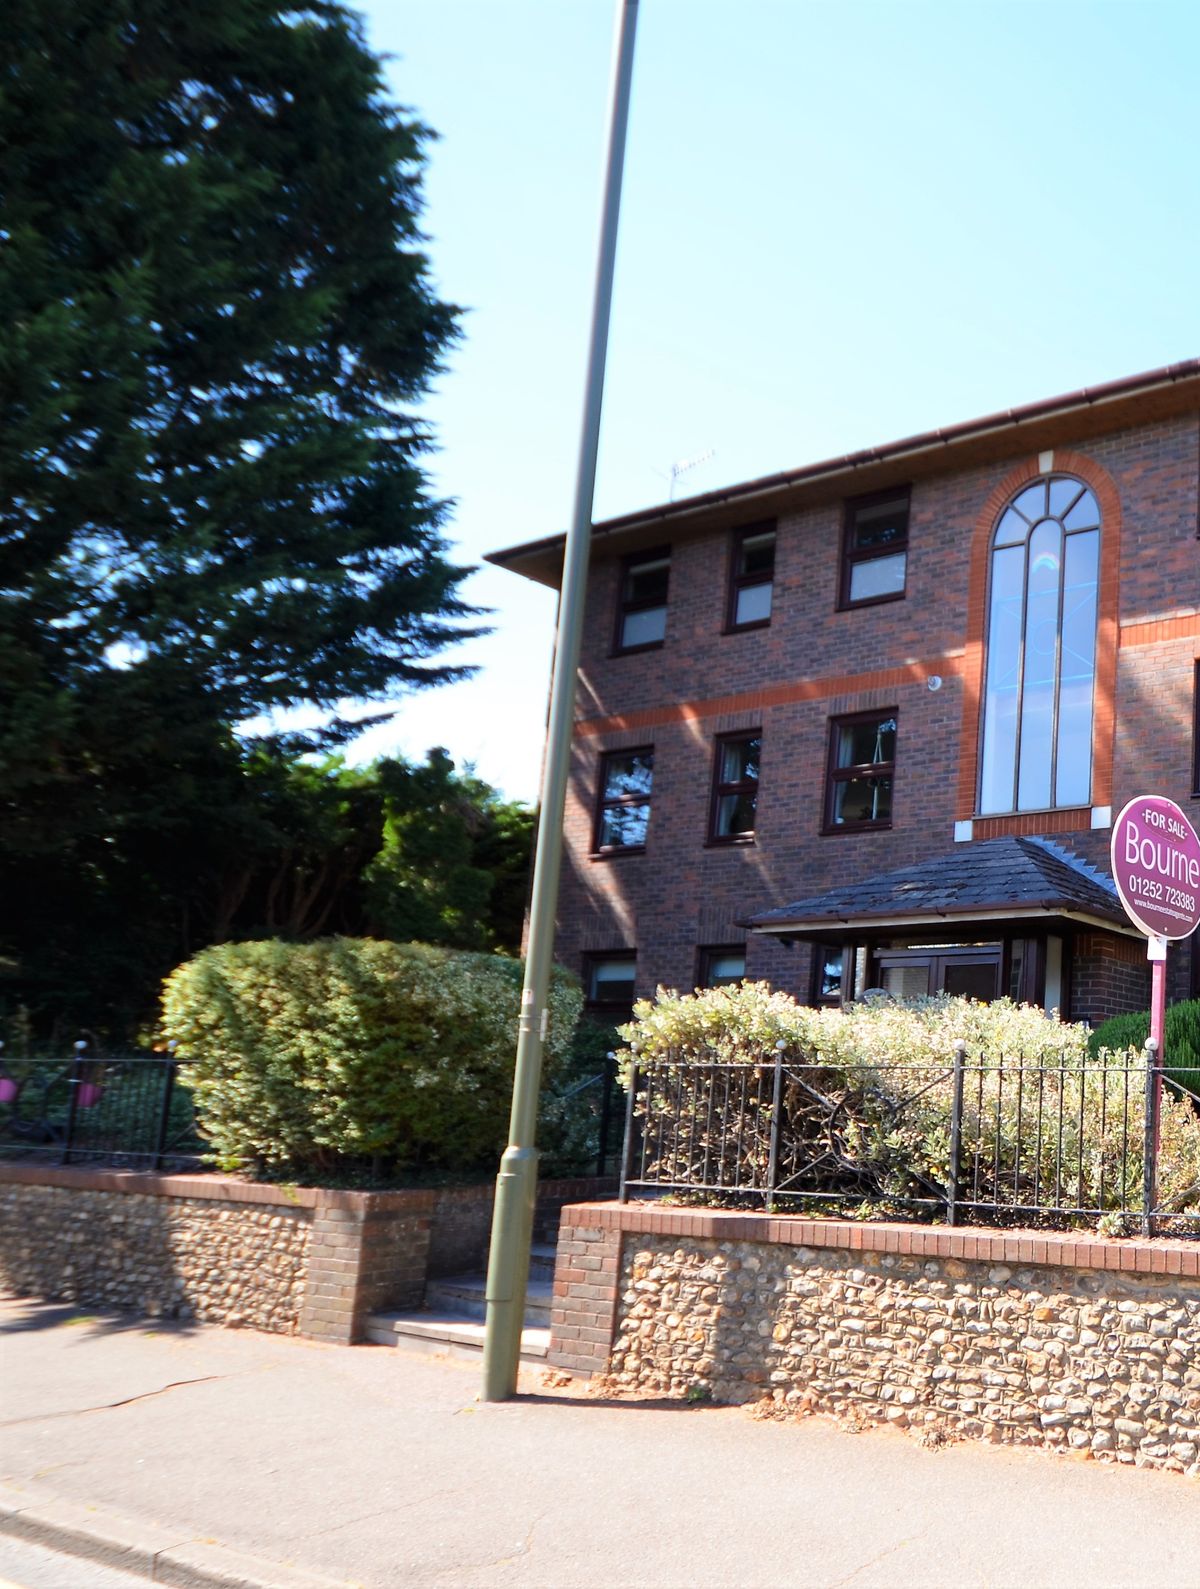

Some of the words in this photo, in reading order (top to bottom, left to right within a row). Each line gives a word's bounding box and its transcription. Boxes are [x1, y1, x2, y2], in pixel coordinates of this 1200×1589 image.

[1144, 809, 1166, 829] FOR
[1167, 818, 1186, 840] SALE
[1125, 820, 1200, 889] Bourne
[1129, 874, 1163, 900] 01252
[1165, 886, 1195, 912] 723383
